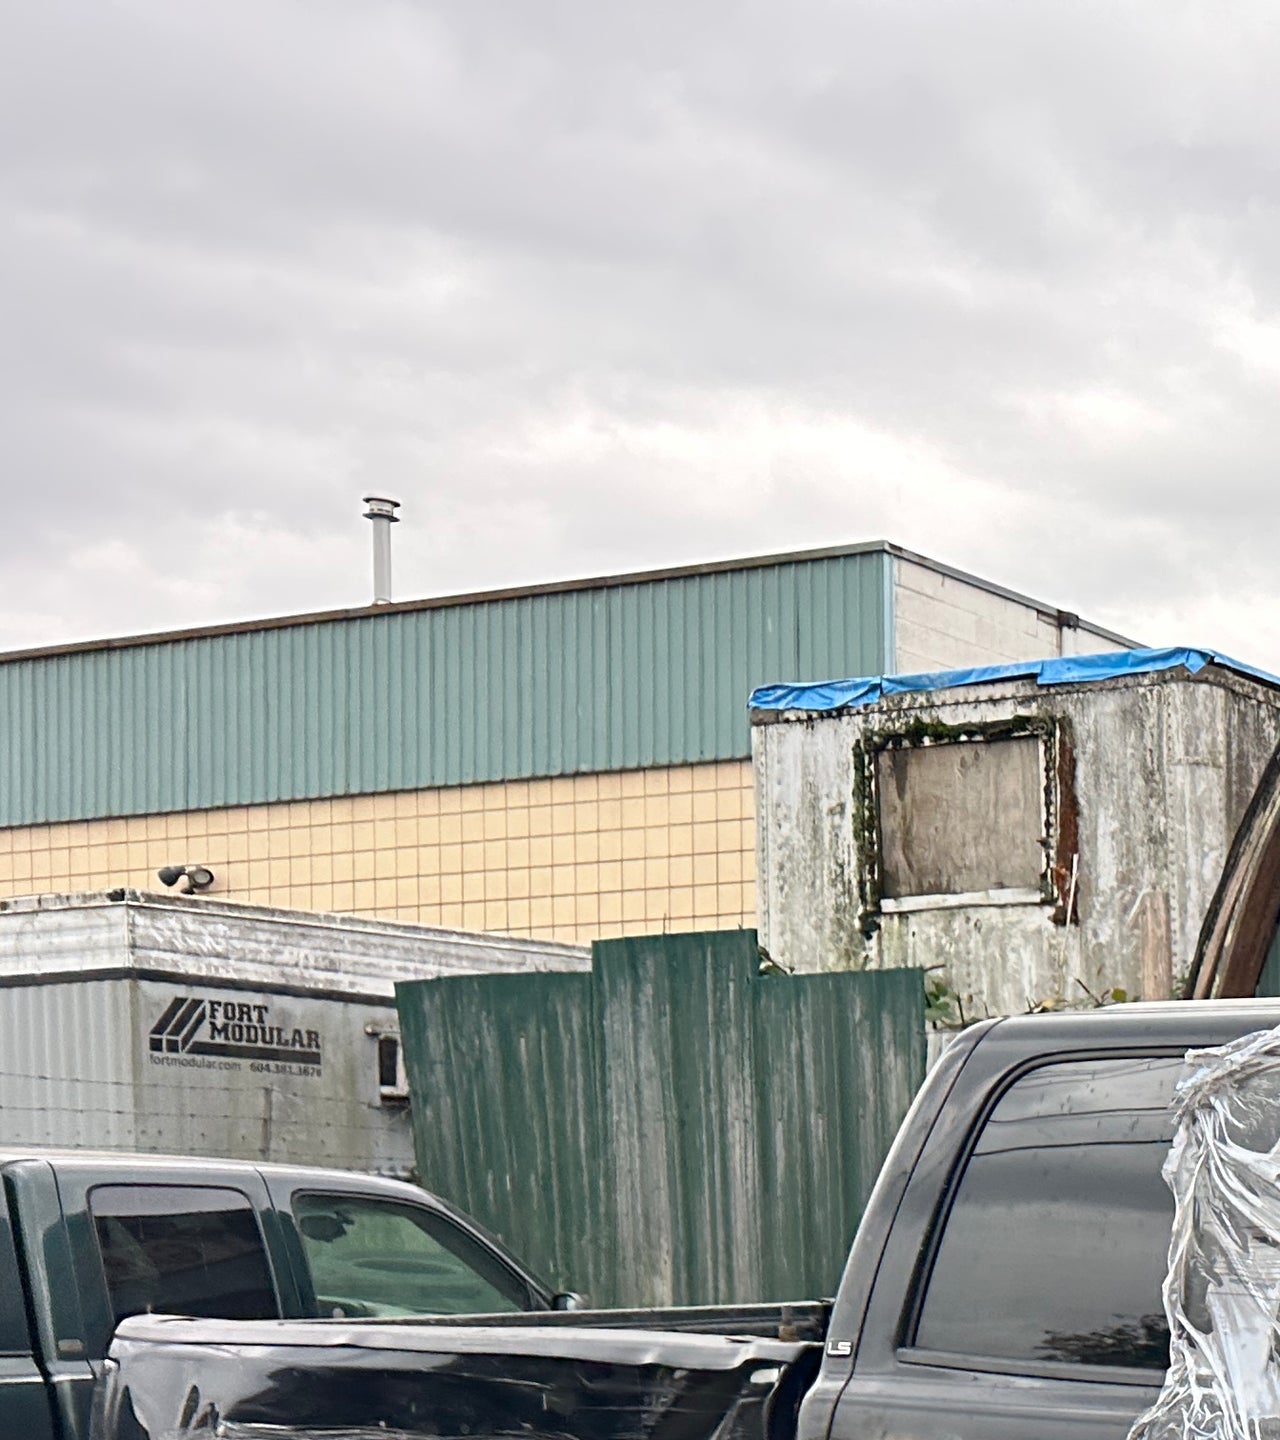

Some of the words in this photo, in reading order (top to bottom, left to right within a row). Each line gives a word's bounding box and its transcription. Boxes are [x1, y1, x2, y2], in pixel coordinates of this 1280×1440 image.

[209, 1001, 268, 1023] FORT
[209, 1021, 321, 1048] MODULAR
[150, 1056, 241, 1071] fortmodular.com
[827, 1341, 852, 1355] LS
